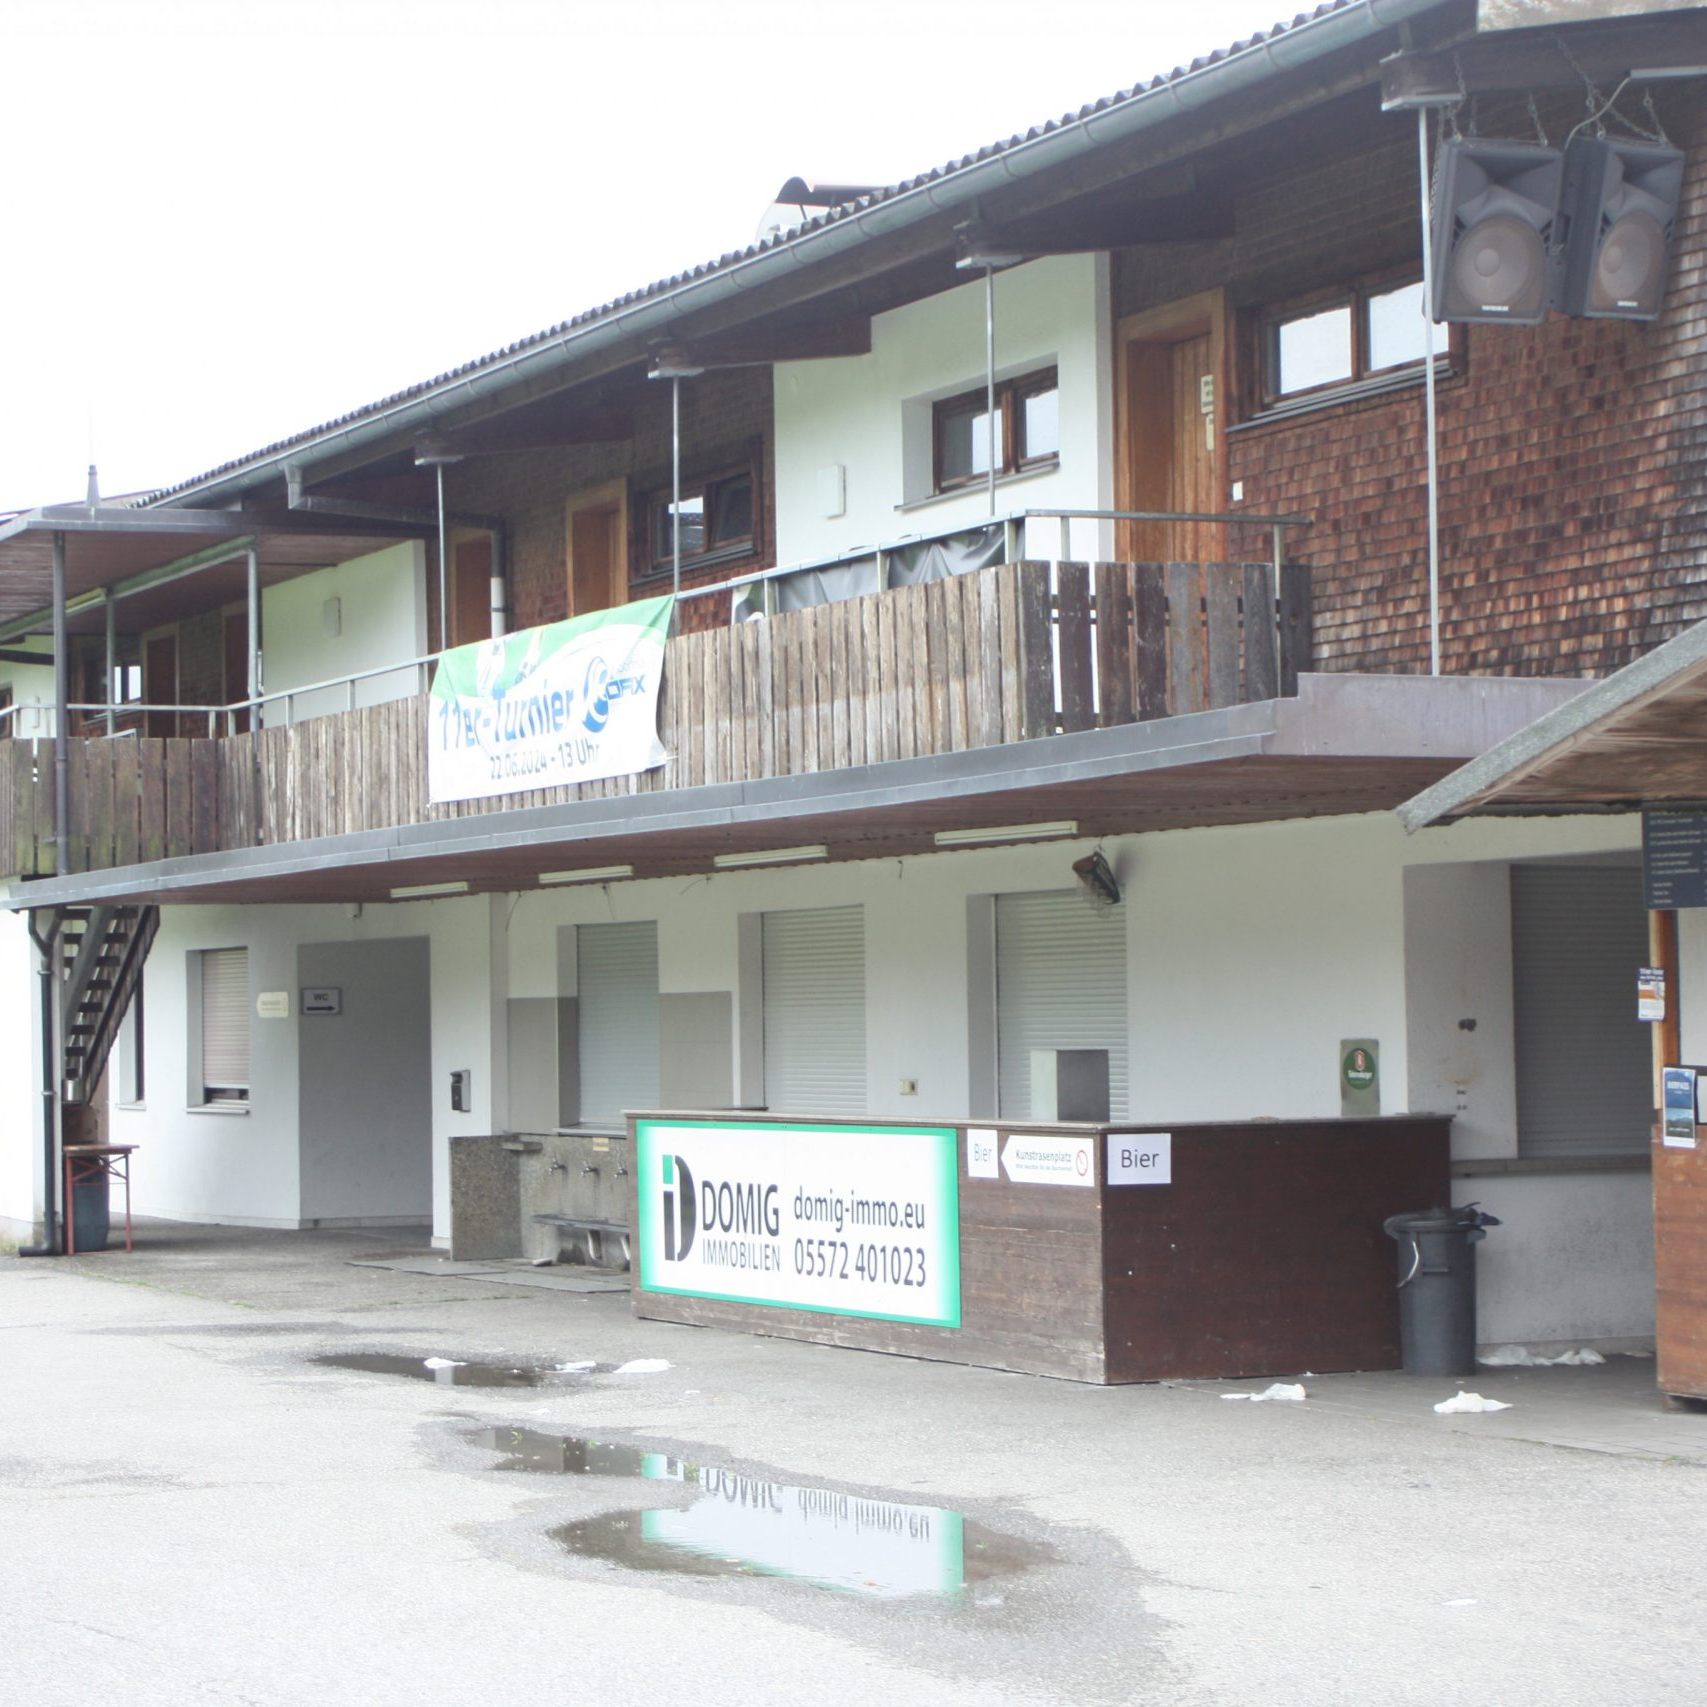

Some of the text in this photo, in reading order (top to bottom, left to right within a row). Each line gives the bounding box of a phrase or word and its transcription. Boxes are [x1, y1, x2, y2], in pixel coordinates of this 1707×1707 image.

[439, 679, 574, 750] 11er-Turnier
[558, 743, 573, 768] 13
[575, 737, 600, 765] Uhr
[313, 993, 329, 1001] WC
[974, 1143, 992, 1162] Bier
[1015, 1149, 1072, 1165] Kunstrasenplatz
[1121, 1149, 1159, 1168] Bier
[702, 1180, 780, 1237] DOMIG
[794, 1186, 926, 1233] domig-immo.eu
[702, 1238, 781, 1273] IMMOBILIEN
[794, 1238, 926, 1288] 05572 401023
